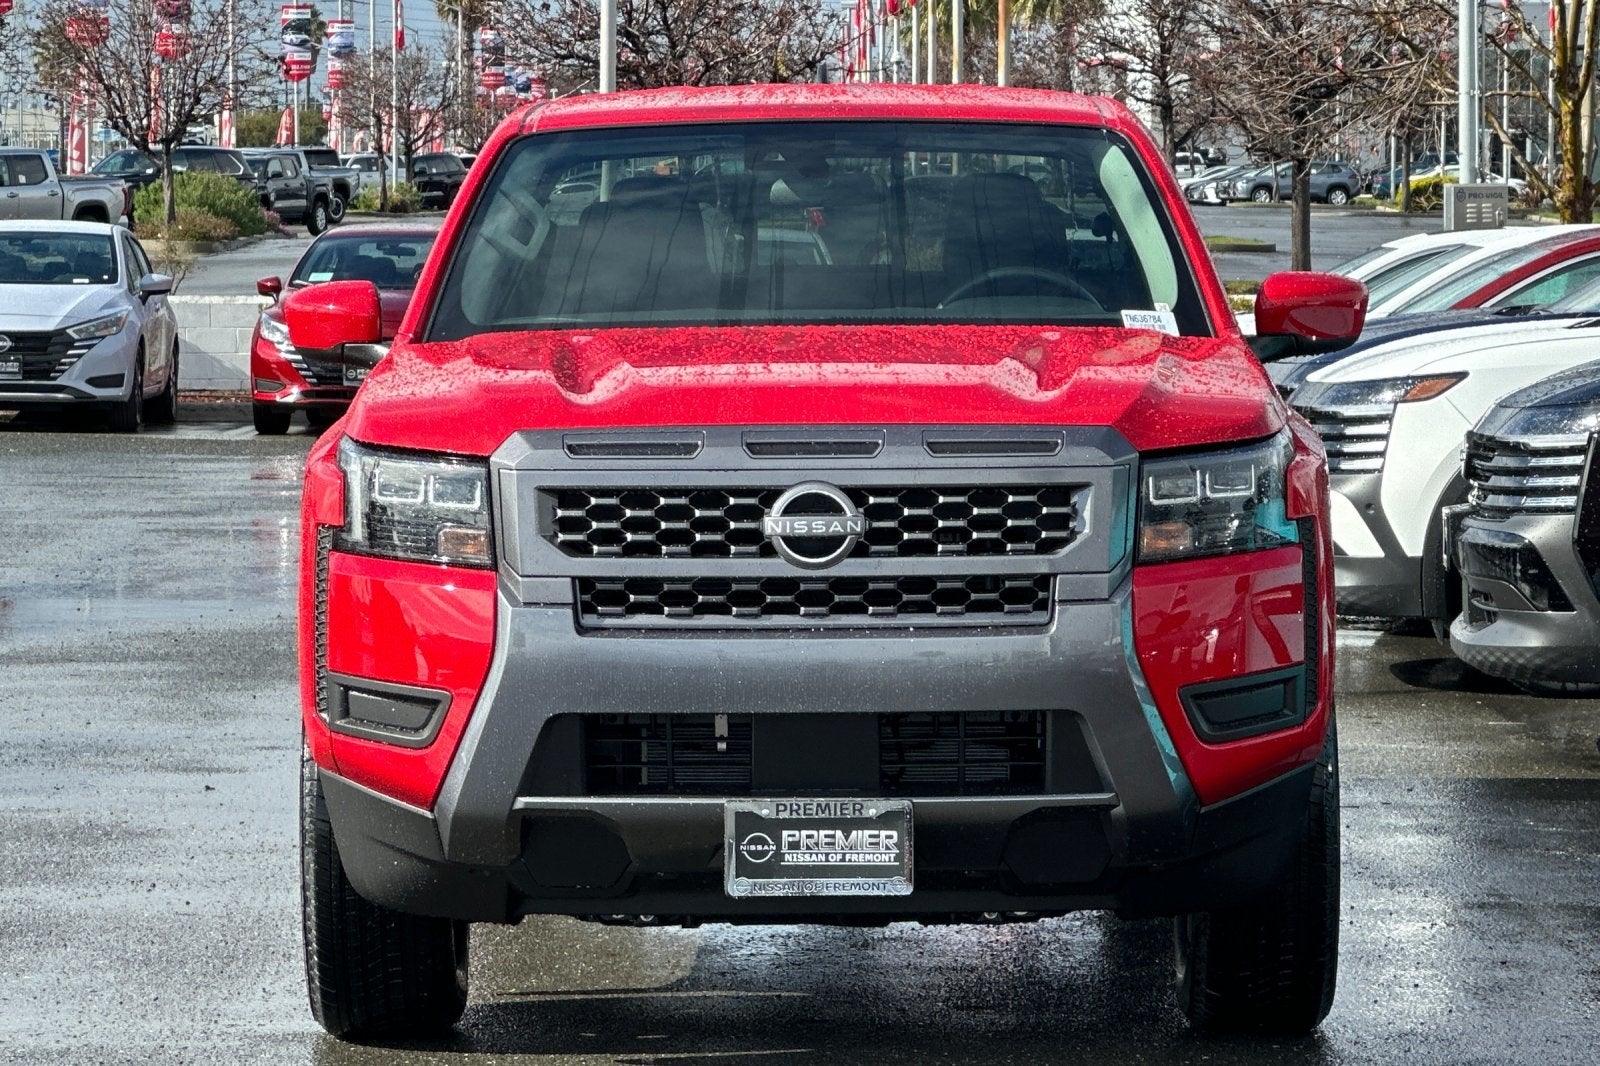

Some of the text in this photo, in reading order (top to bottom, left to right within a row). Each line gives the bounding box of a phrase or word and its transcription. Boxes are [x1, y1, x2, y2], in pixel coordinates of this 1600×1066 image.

[767, 521, 861, 533] NISSAN
[775, 803, 864, 817] PREMIER
[781, 830, 899, 850] PREMIER
[784, 853, 896, 862] NISSAN OF FREMONT
[753, 882, 800, 893] NISSAN
[803, 882, 821, 893] OF
[825, 882, 888, 892] FREMONT
